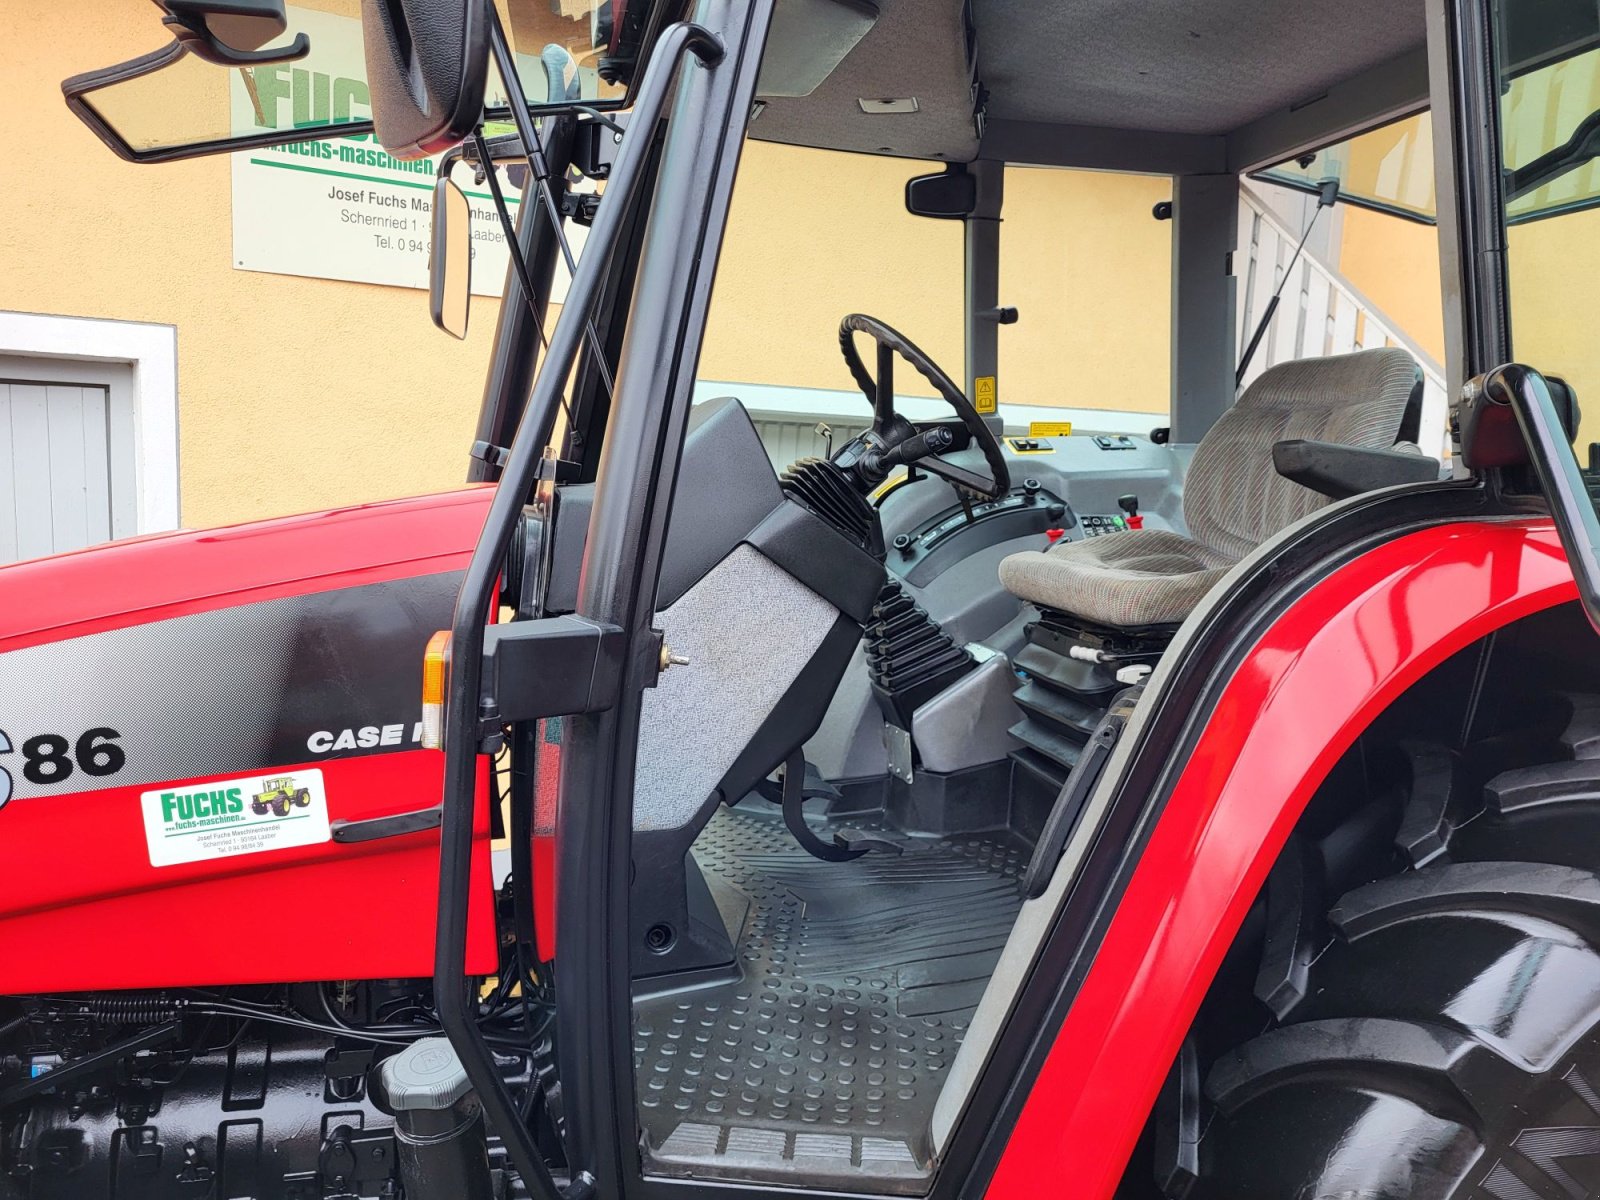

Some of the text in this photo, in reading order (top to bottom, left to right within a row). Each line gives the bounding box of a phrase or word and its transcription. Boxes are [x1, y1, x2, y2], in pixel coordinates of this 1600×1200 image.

[328, 186, 365, 203] Josef
[369, 191, 407, 209] Fuchs
[341, 209, 408, 230] Schernried
[411, 219, 417, 231] 1
[374, 234, 394, 249] Tel.
[397, 238, 406, 250] 0
[409, 240, 423, 253] 94
[307, 723, 404, 753] CASE
[160, 787, 244, 823] FUCHS
